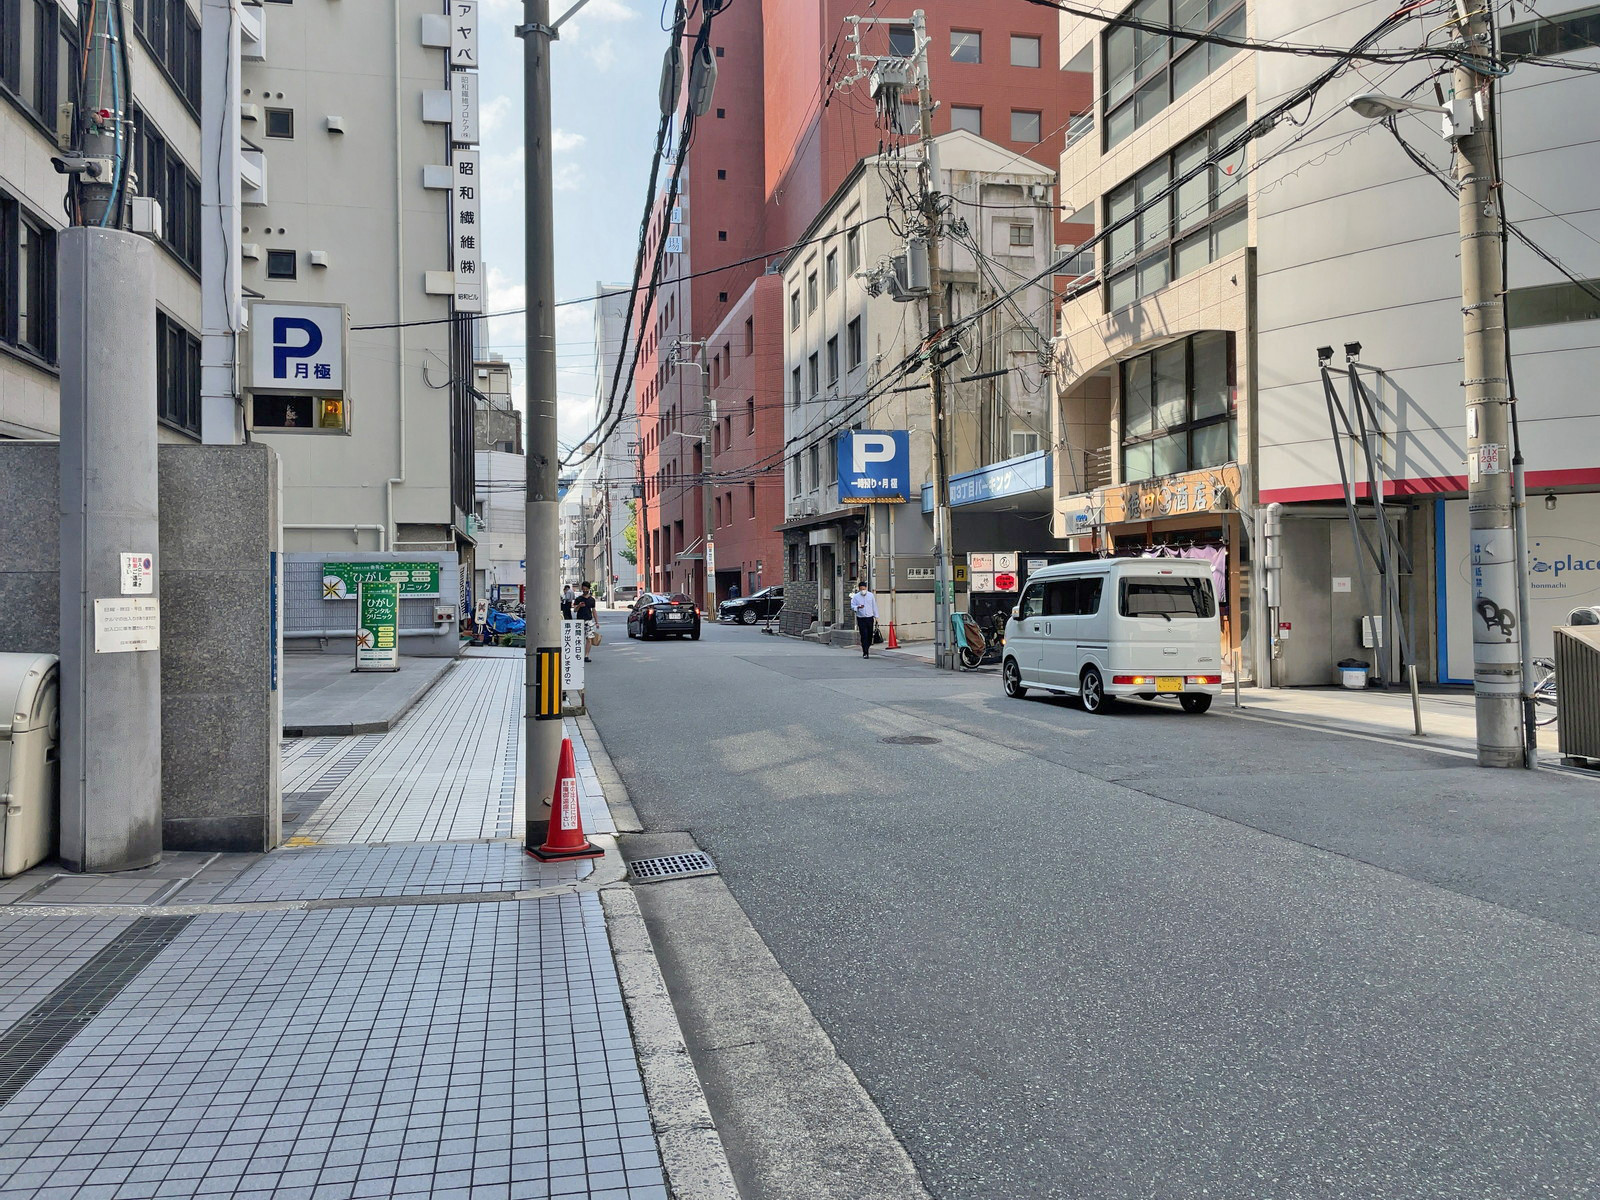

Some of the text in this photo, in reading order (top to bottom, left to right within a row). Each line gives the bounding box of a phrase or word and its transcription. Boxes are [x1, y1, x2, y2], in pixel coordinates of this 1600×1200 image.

[457, 293, 479, 301] 昭和ビル
[273, 316, 323, 379] P
[294, 362, 331, 379] 月極
[853, 434, 896, 473] P
[1554, 554, 1600, 577] plac
[352, 572, 388, 583] ひがし
[366, 598, 394, 608] ひがし
[574, 622, 582, 661] 夜間・休日も
[564, 622, 572, 685] 車が出入りしますので
